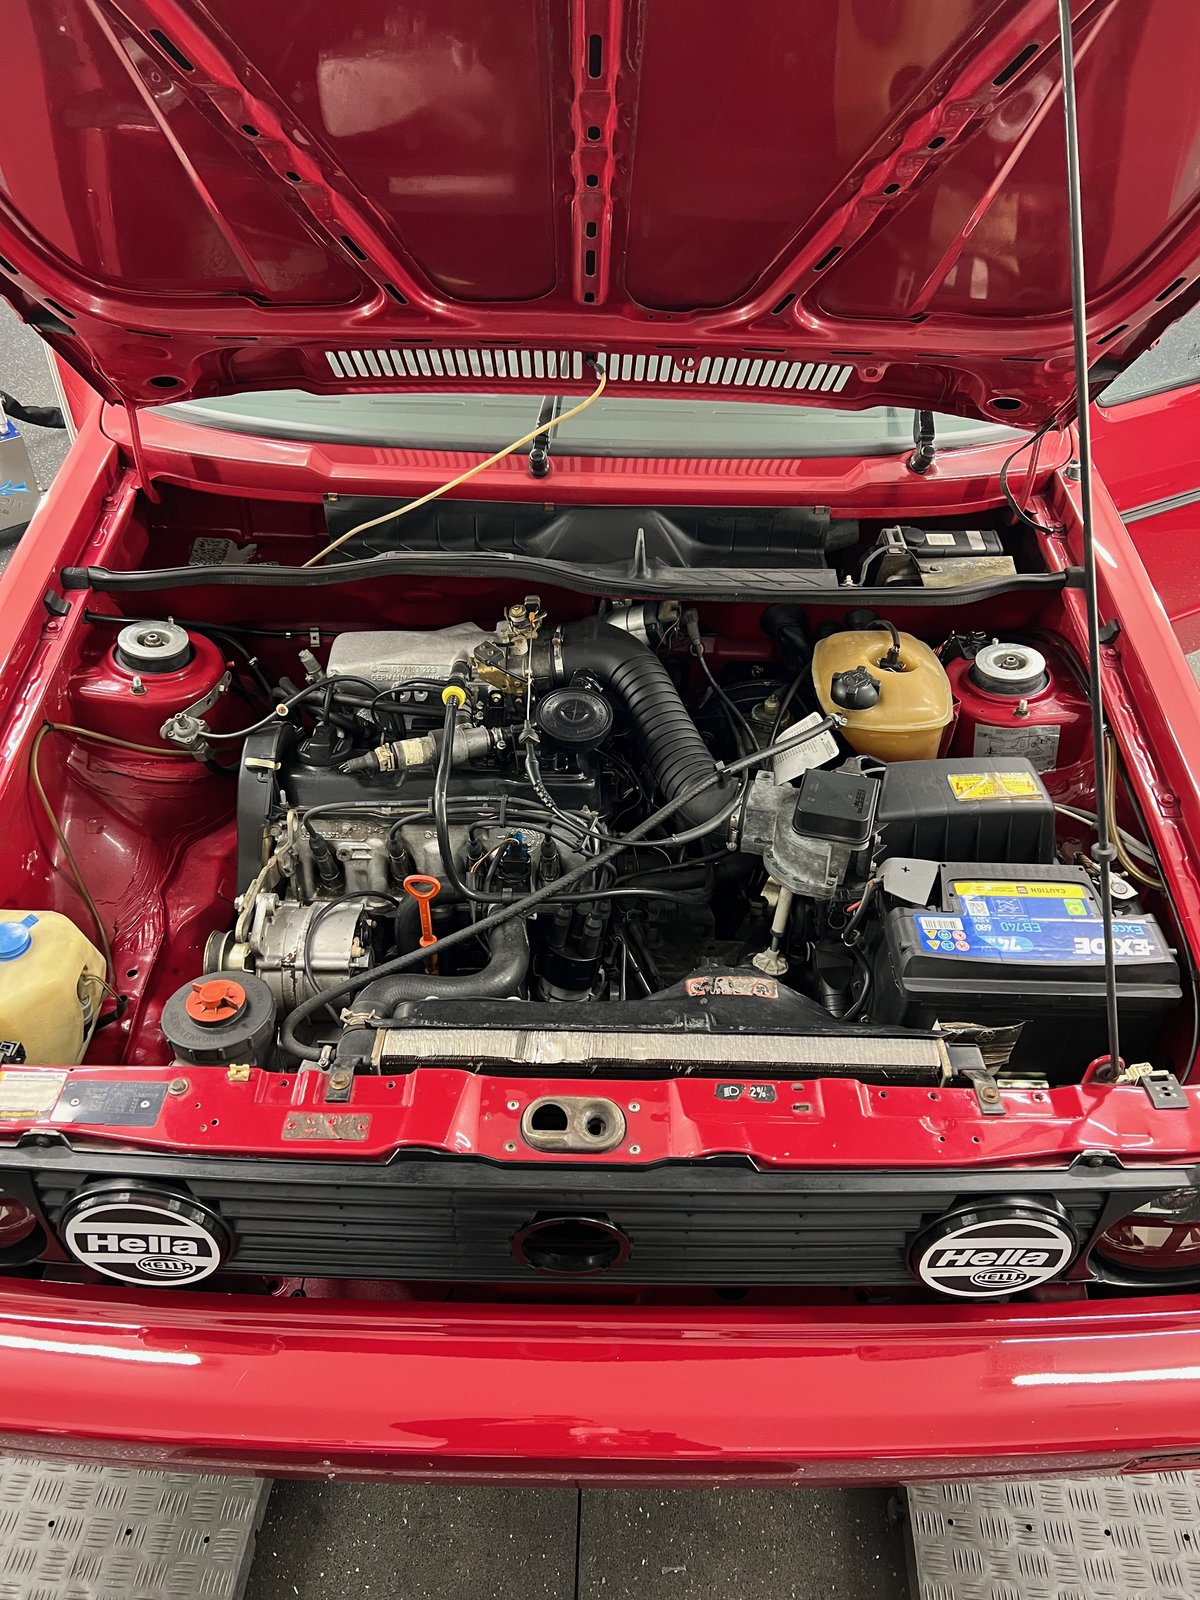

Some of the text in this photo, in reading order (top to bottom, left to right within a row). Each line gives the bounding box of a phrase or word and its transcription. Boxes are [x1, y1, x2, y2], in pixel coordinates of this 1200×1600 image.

[1000, 921, 1042, 933] EB740
[1101, 924, 1144, 935] Exce
[1073, 937, 1154, 955] EXDE
[749, 1086, 767, 1099] 2%
[86, 1234, 198, 1255] Hella
[935, 1249, 1051, 1267] Hella
[143, 1260, 193, 1272] HELLA
[976, 1272, 1028, 1283] HELLA
